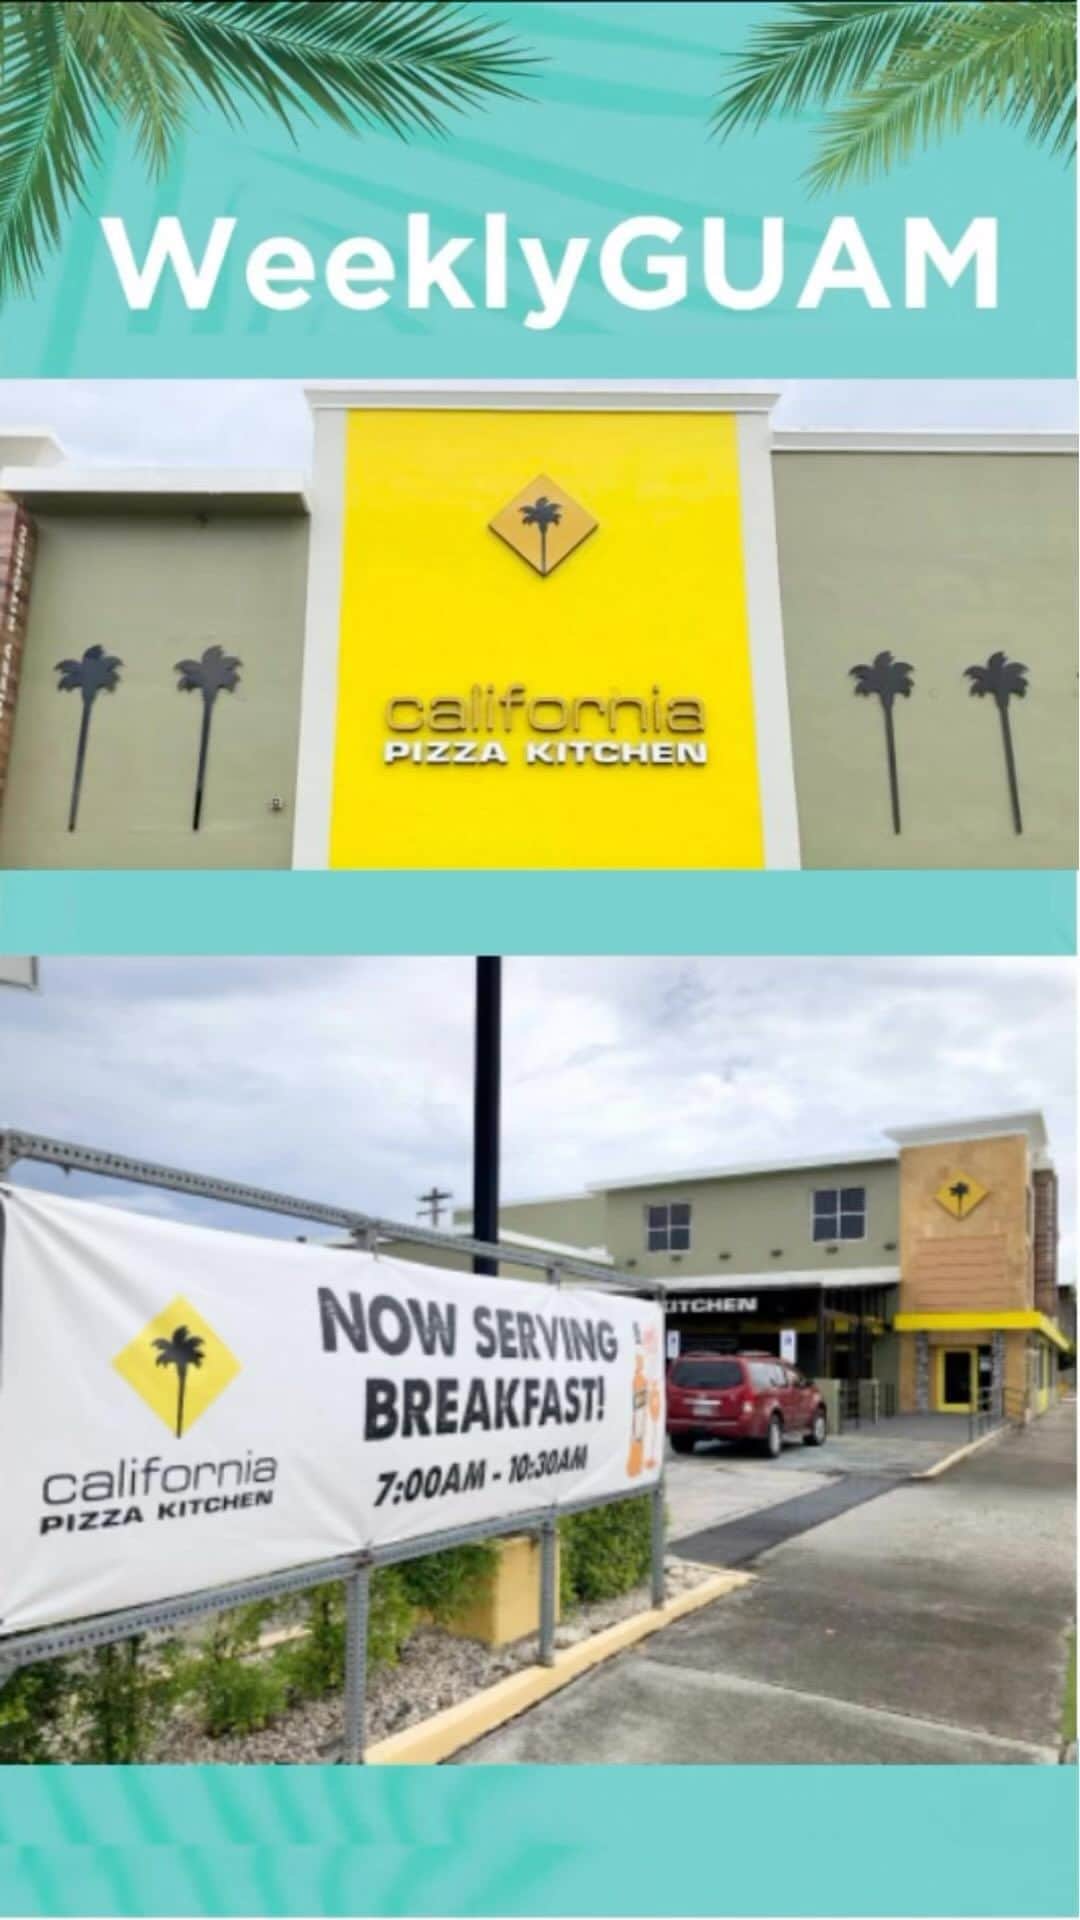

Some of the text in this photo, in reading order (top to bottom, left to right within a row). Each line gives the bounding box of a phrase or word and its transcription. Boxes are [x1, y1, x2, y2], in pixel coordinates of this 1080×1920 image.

[385, 683, 706, 733] california
[383, 741, 708, 765] PIZZA KITCHEN
[317, 1286, 618, 1362] NOW SERVING
[364, 1375, 606, 1441] BREAKFAST!
[42, 1450, 278, 1506] california
[372, 1459, 486, 1507] 7:00AM
[508, 1443, 588, 1484] 10:30AM
[40, 1488, 273, 1536] PIZZA KITCHEN
